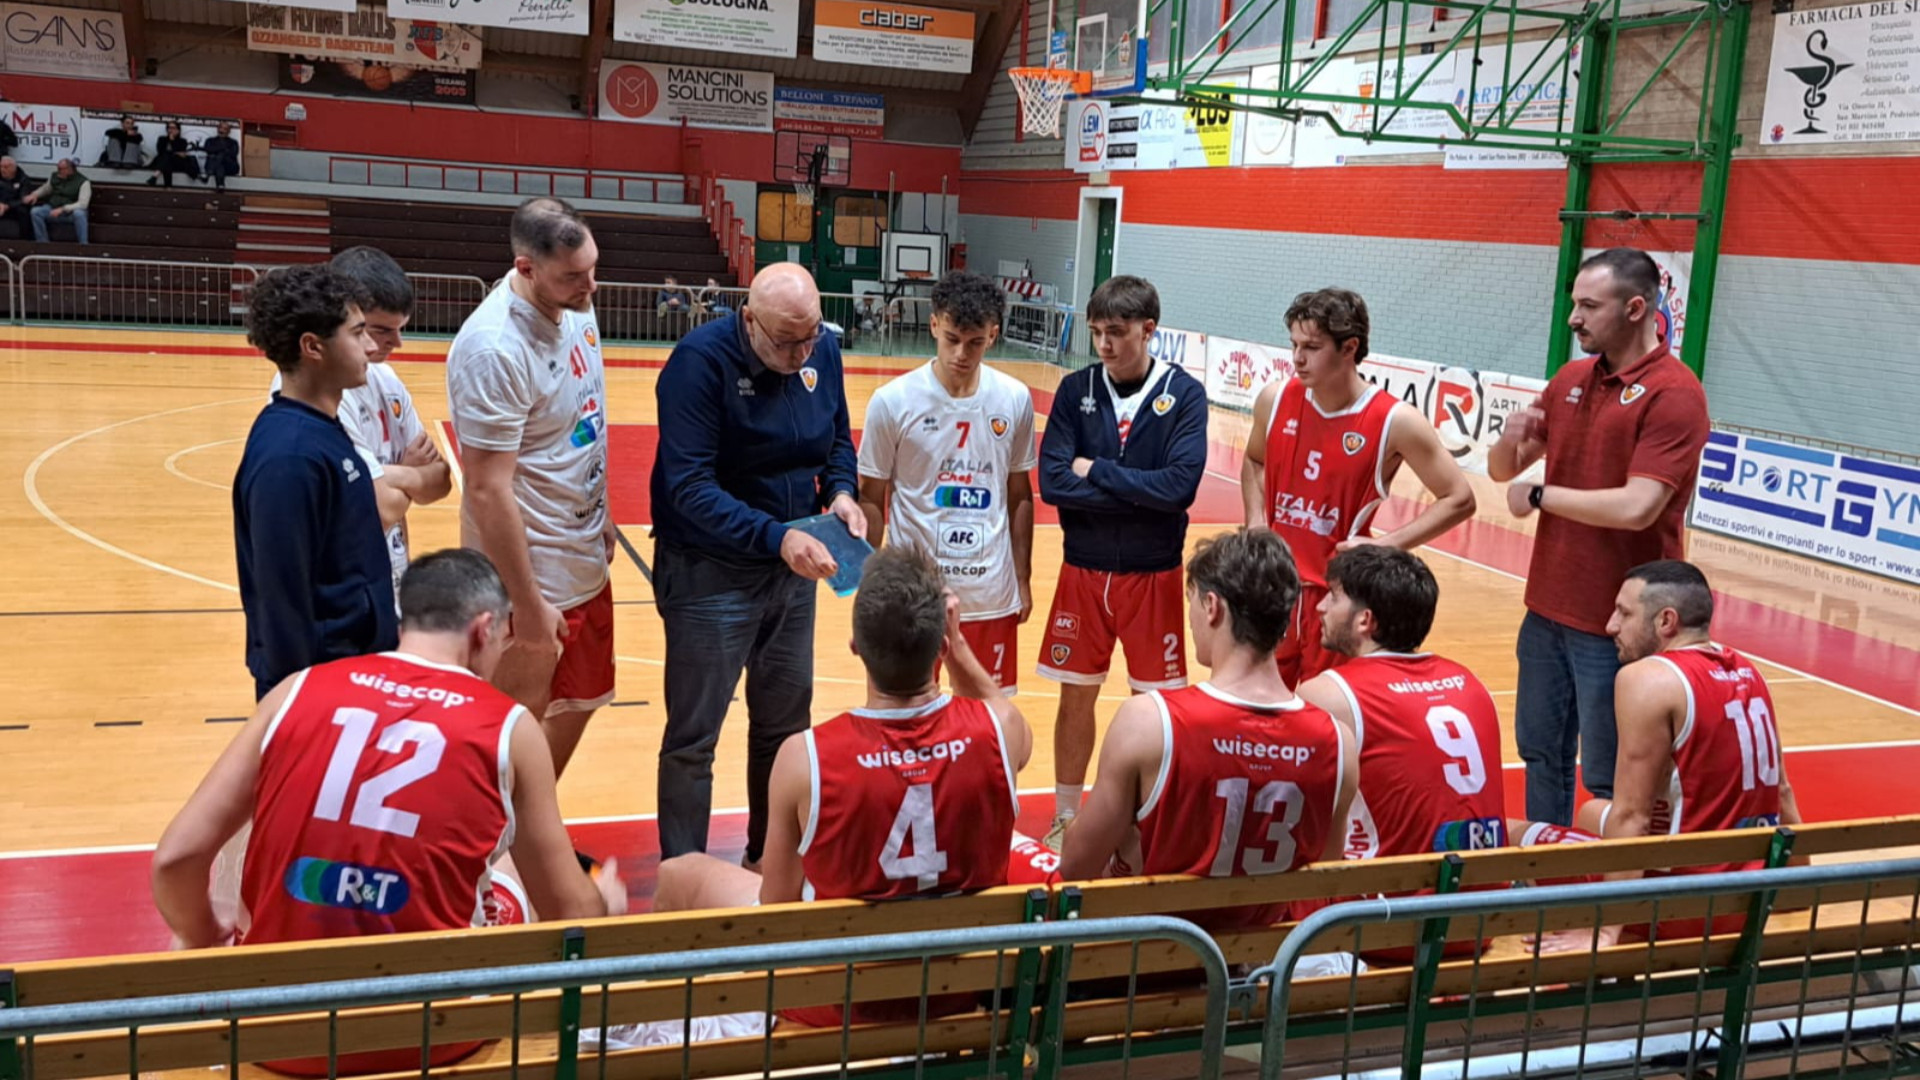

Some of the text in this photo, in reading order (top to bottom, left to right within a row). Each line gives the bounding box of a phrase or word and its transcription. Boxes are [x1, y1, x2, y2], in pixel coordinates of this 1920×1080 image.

[859, 8, 934, 31] claber
[1789, 7, 1862, 27] FARMACIA
[1869, 2, 1898, 17] DEL
[668, 68, 743, 88] MANCINI
[667, 84, 768, 106] SOLUTIONS
[780, 89, 878, 105] BELLONI STEFANO
[12, 111, 68, 135] Mate
[1082, 115, 1099, 133] LEM
[17, 134, 71, 160] magia
[956, 421, 971, 448] 7
[939, 458, 993, 474] ITALIA
[1304, 450, 1322, 481] 5
[1276, 492, 1339, 520] ITALIA
[949, 531, 974, 545] AFC
[1696, 510, 1729, 527] Attrezzi
[1731, 518, 1766, 540] sportivi
[1767, 530, 1774, 540] e
[1775, 529, 1816, 550] impianti
[1816, 544, 1835, 556] per
[1836, 544, 1846, 559] lo
[1848, 550, 1878, 567] sport
[940, 564, 987, 577] isecap
[993, 643, 1005, 671] 7
[1163, 633, 1178, 661] 2
[350, 671, 467, 709] wisecap
[1388, 675, 1465, 694] wisecap
[857, 739, 966, 769] wisecap
[1213, 735, 1310, 767] wisecap
[1425, 705, 1486, 795] 9
[1724, 696, 1779, 791] 10
[313, 707, 447, 838] 12
[878, 783, 948, 891] 4
[1209, 777, 1305, 877] 13
[1469, 819, 1500, 850] R&T
[336, 865, 399, 910] R&T
